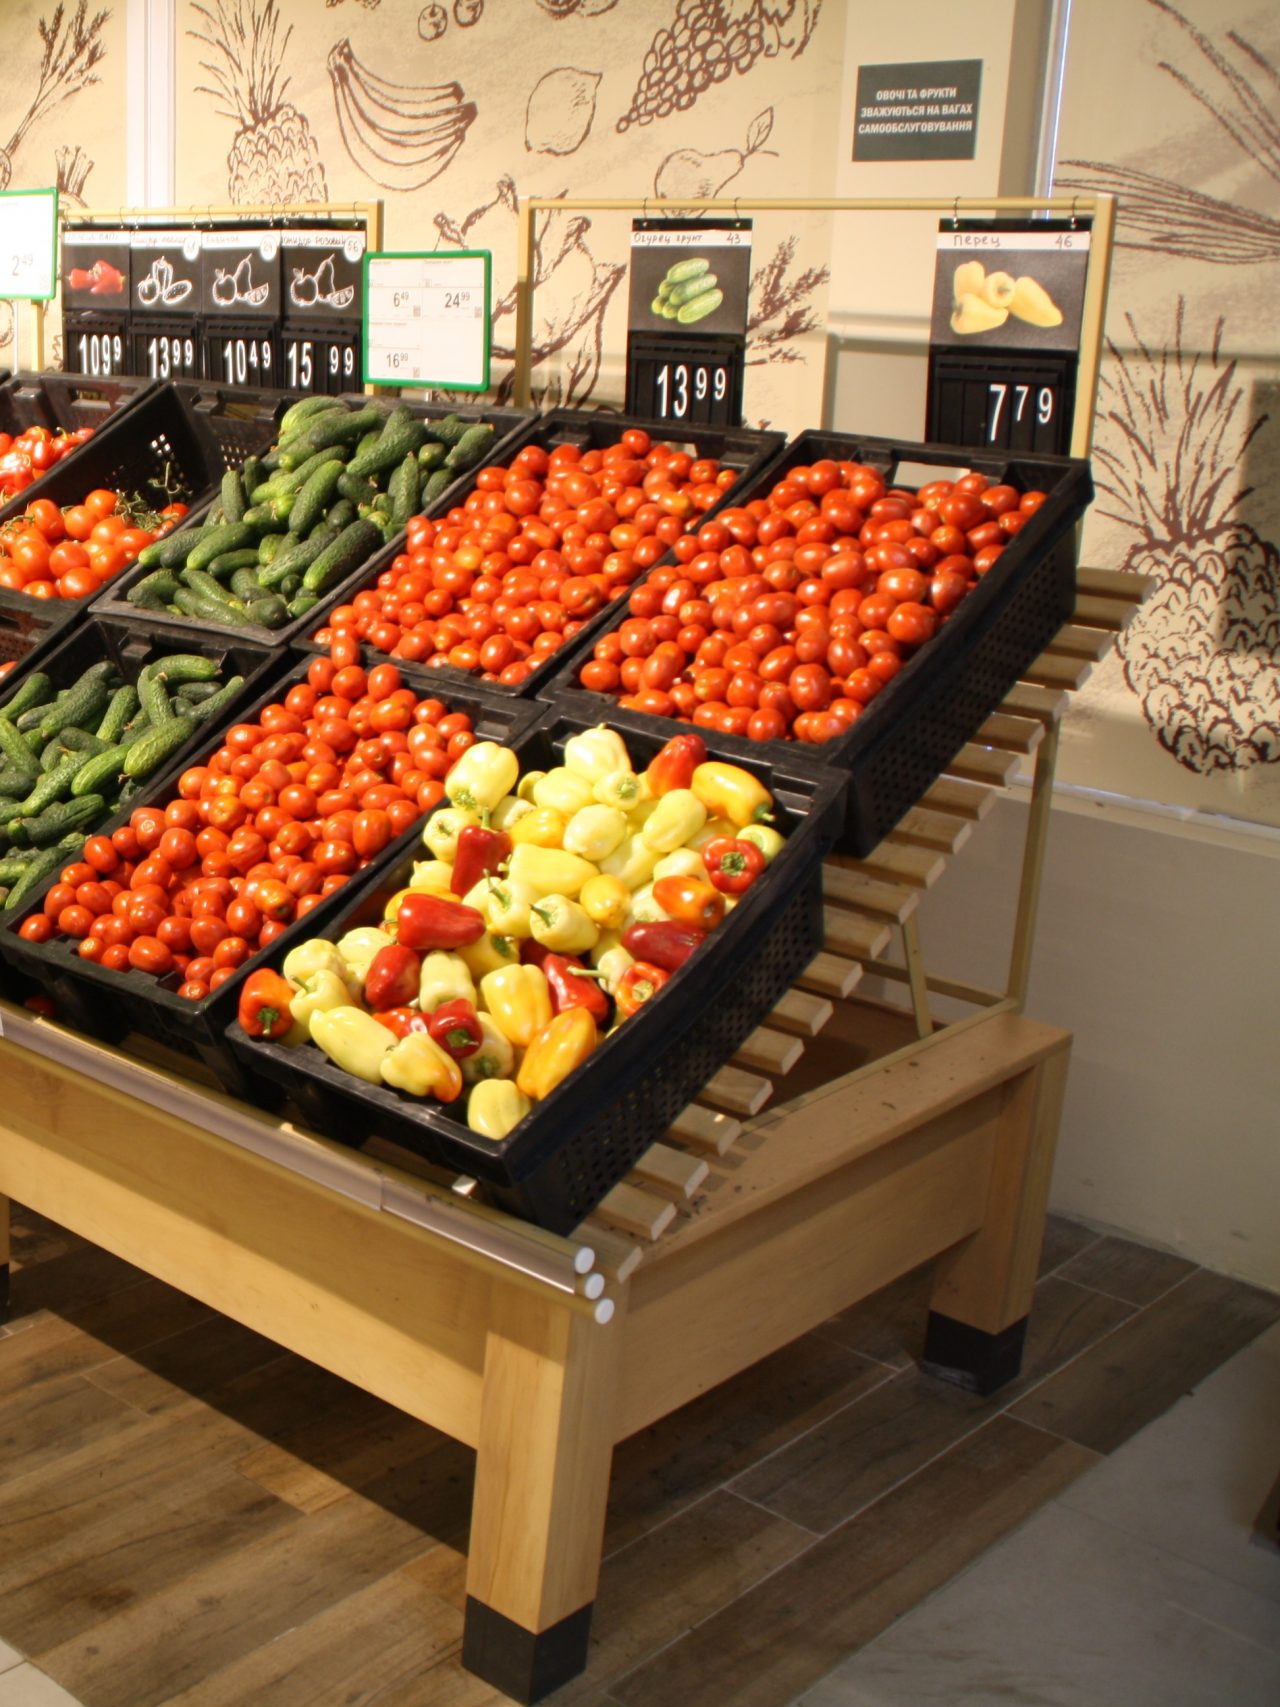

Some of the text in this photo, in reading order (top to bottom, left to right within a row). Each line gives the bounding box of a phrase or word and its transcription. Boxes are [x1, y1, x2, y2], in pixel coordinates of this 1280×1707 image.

[876, 87, 957, 101] ОВОЧІ ТА ФРУКТИ
[861, 103, 973, 118] ЗВАЖУЮТЬСЯ НА ВАГАХ
[858, 121, 973, 134] САМООБСЛУГОВУВАННЯ
[726, 232, 741, 244] 43
[1055, 234, 1073, 249] 46
